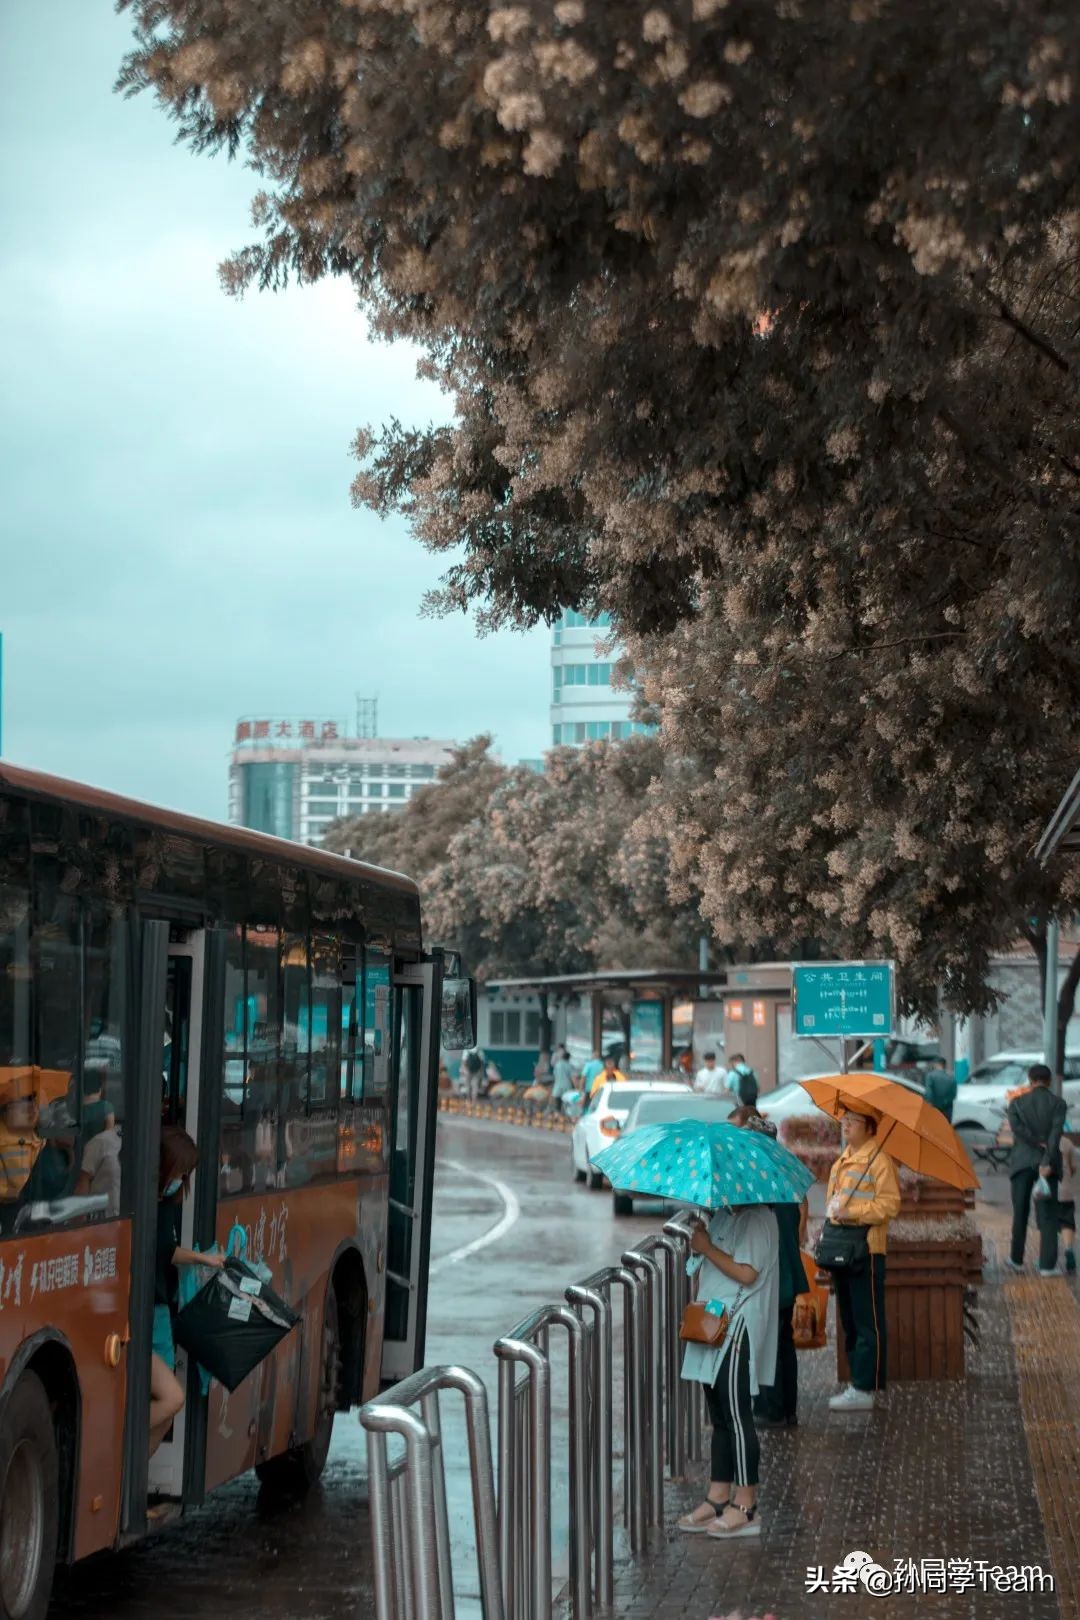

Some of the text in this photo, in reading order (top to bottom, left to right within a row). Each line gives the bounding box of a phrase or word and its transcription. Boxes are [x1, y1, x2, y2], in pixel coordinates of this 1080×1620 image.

[803, 971, 883, 983] 公共卫生间
